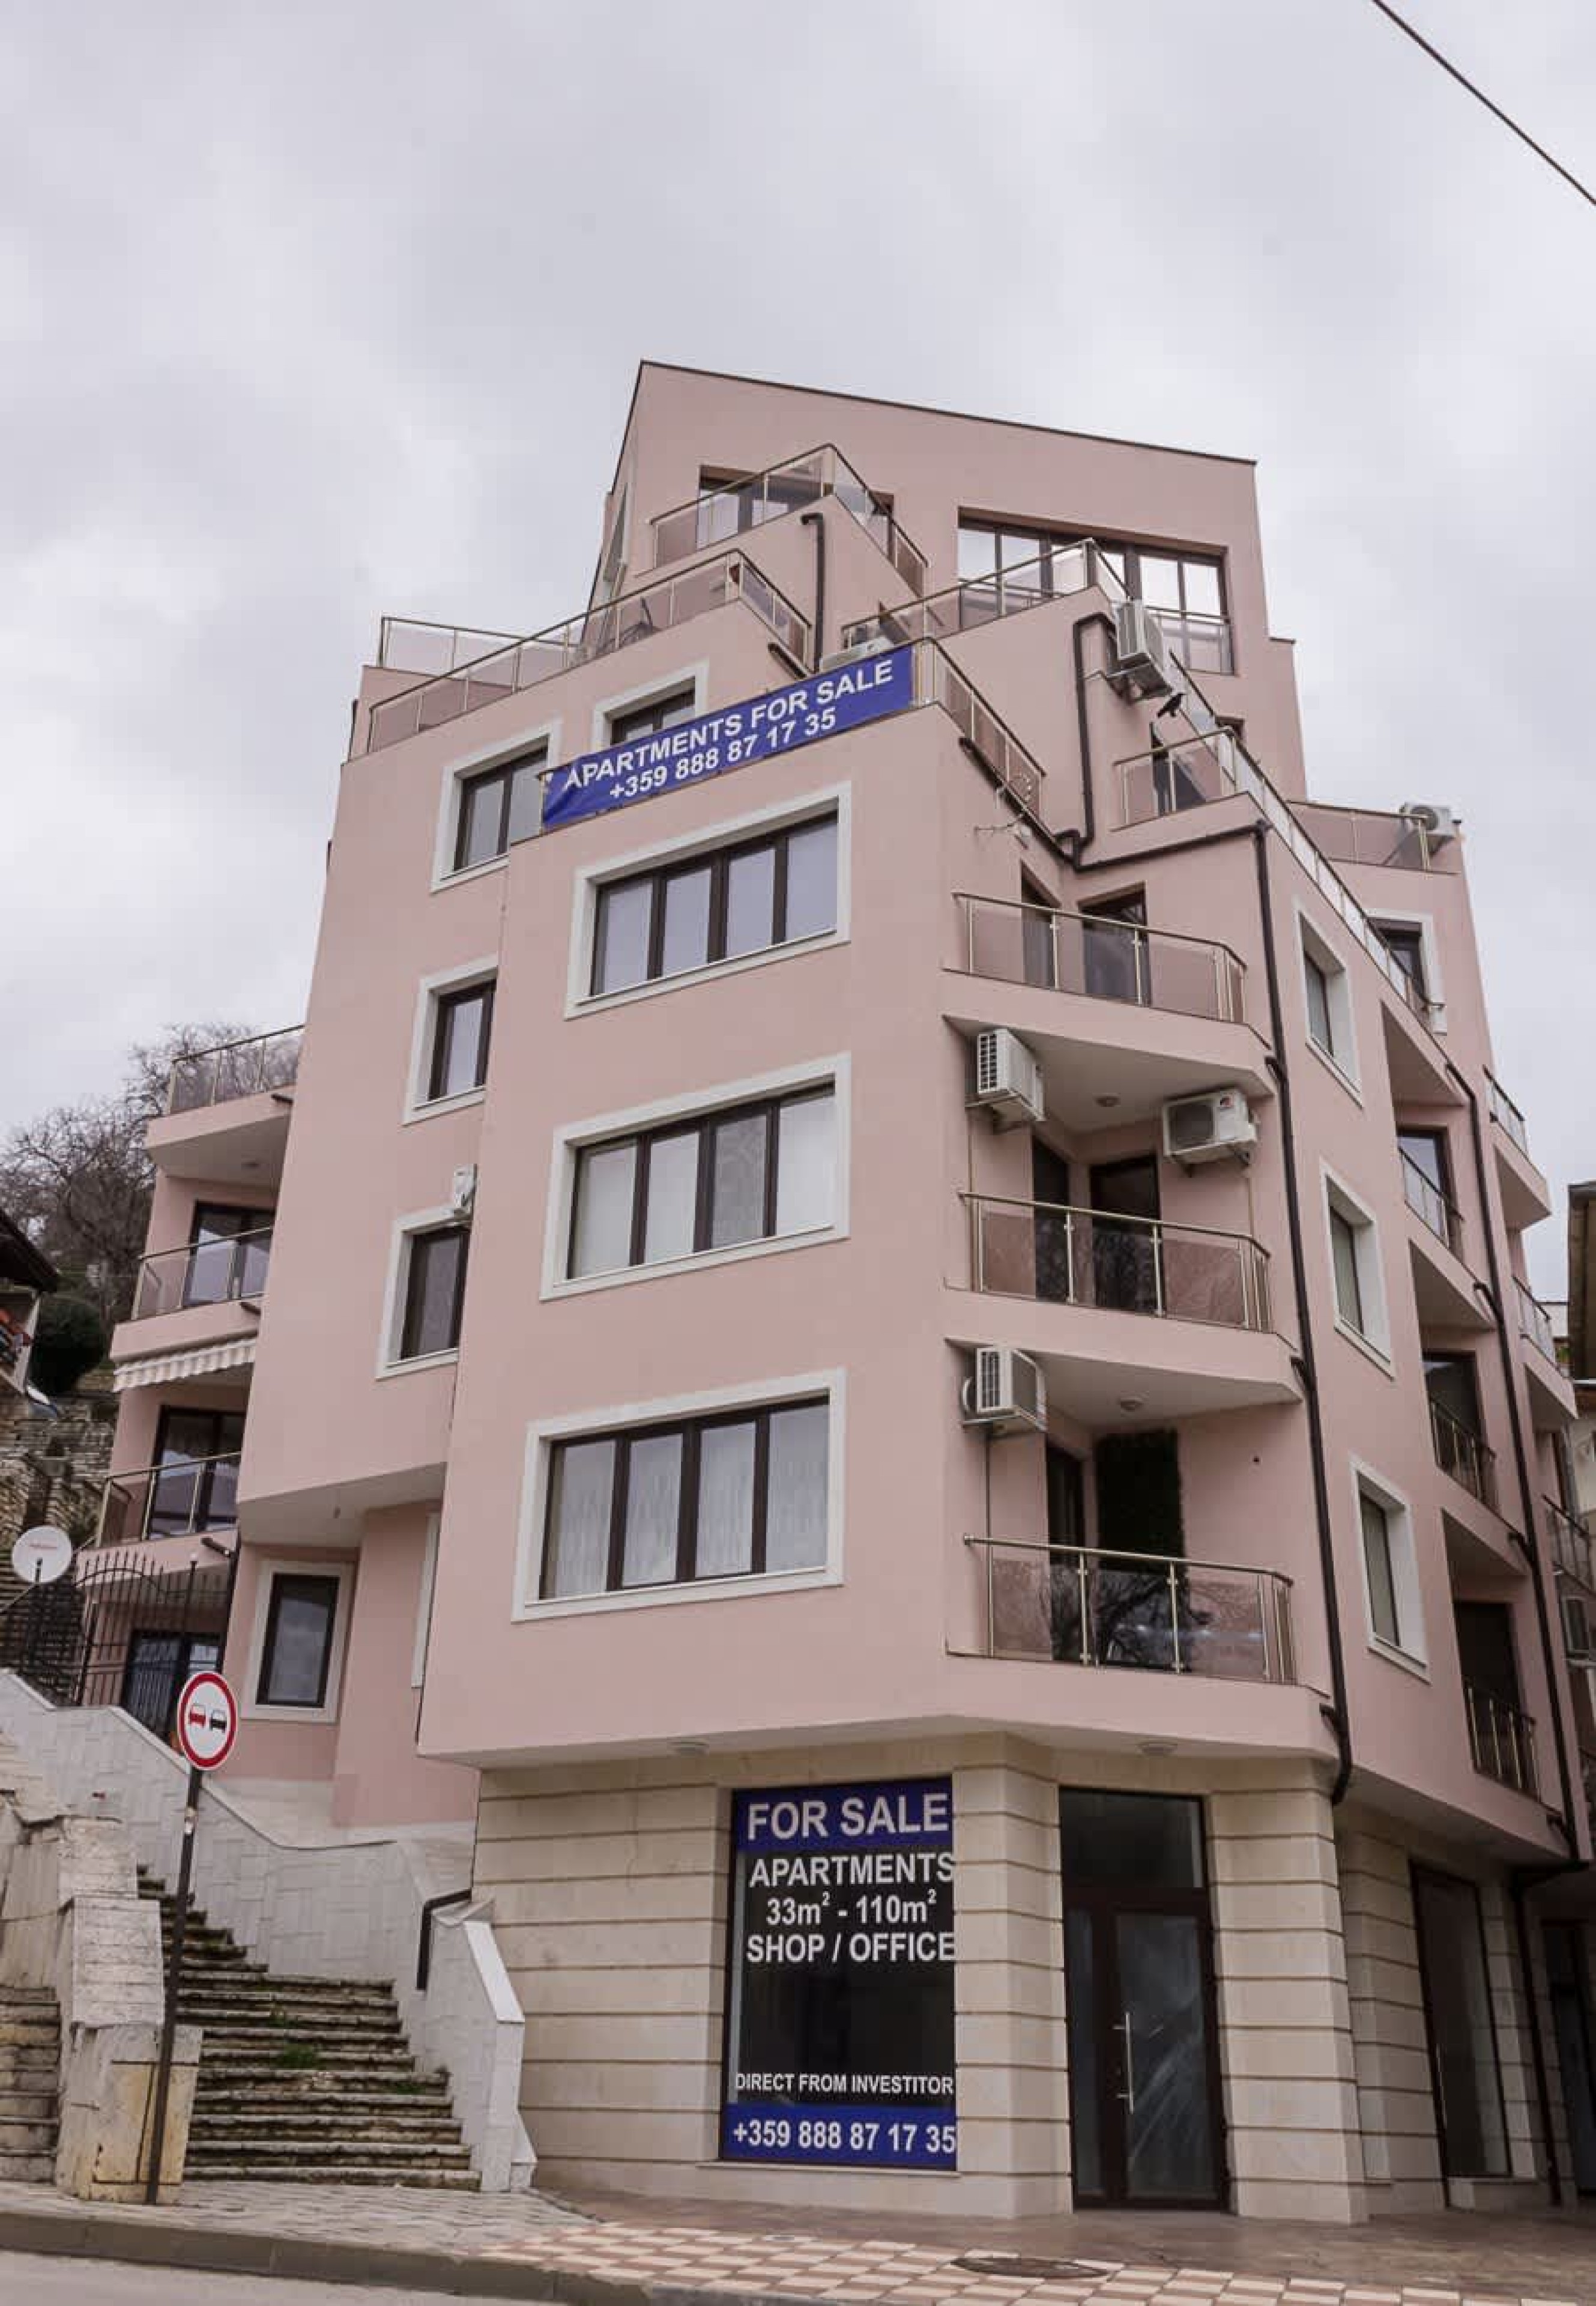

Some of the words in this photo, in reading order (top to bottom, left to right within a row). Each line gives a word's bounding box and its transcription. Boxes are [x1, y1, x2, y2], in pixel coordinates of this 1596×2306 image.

[564, 714, 742, 790] APARTMENTS
[751, 691, 808, 730] FOR
[817, 659, 893, 705] SALE
[609, 768, 667, 800] +359
[676, 749, 719, 781] 888
[727, 734, 758, 763] 87
[767, 722, 796, 749] 17
[805, 707, 836, 736] 35
[749, 1800, 829, 1840] FOR
[841, 1794, 948, 1835] SALE
[750, 1853, 955, 1886] APARTMENTS
[746, 1933, 826, 1963] SHOP
[832, 1933, 841, 1963] /
[849, 1932, 955, 1962] OFFICE
[736, 2074, 794, 2091] DIRECT
[799, 2074, 846, 2092] FROM
[852, 2075, 953, 2095] INVESTITOR
[733, 2119, 791, 2147] +359
[798, 2120, 841, 2149] 888
[850, 2122, 880, 2150] 87
[888, 2123, 917, 2152] 17
[926, 2124, 955, 2153] 35
